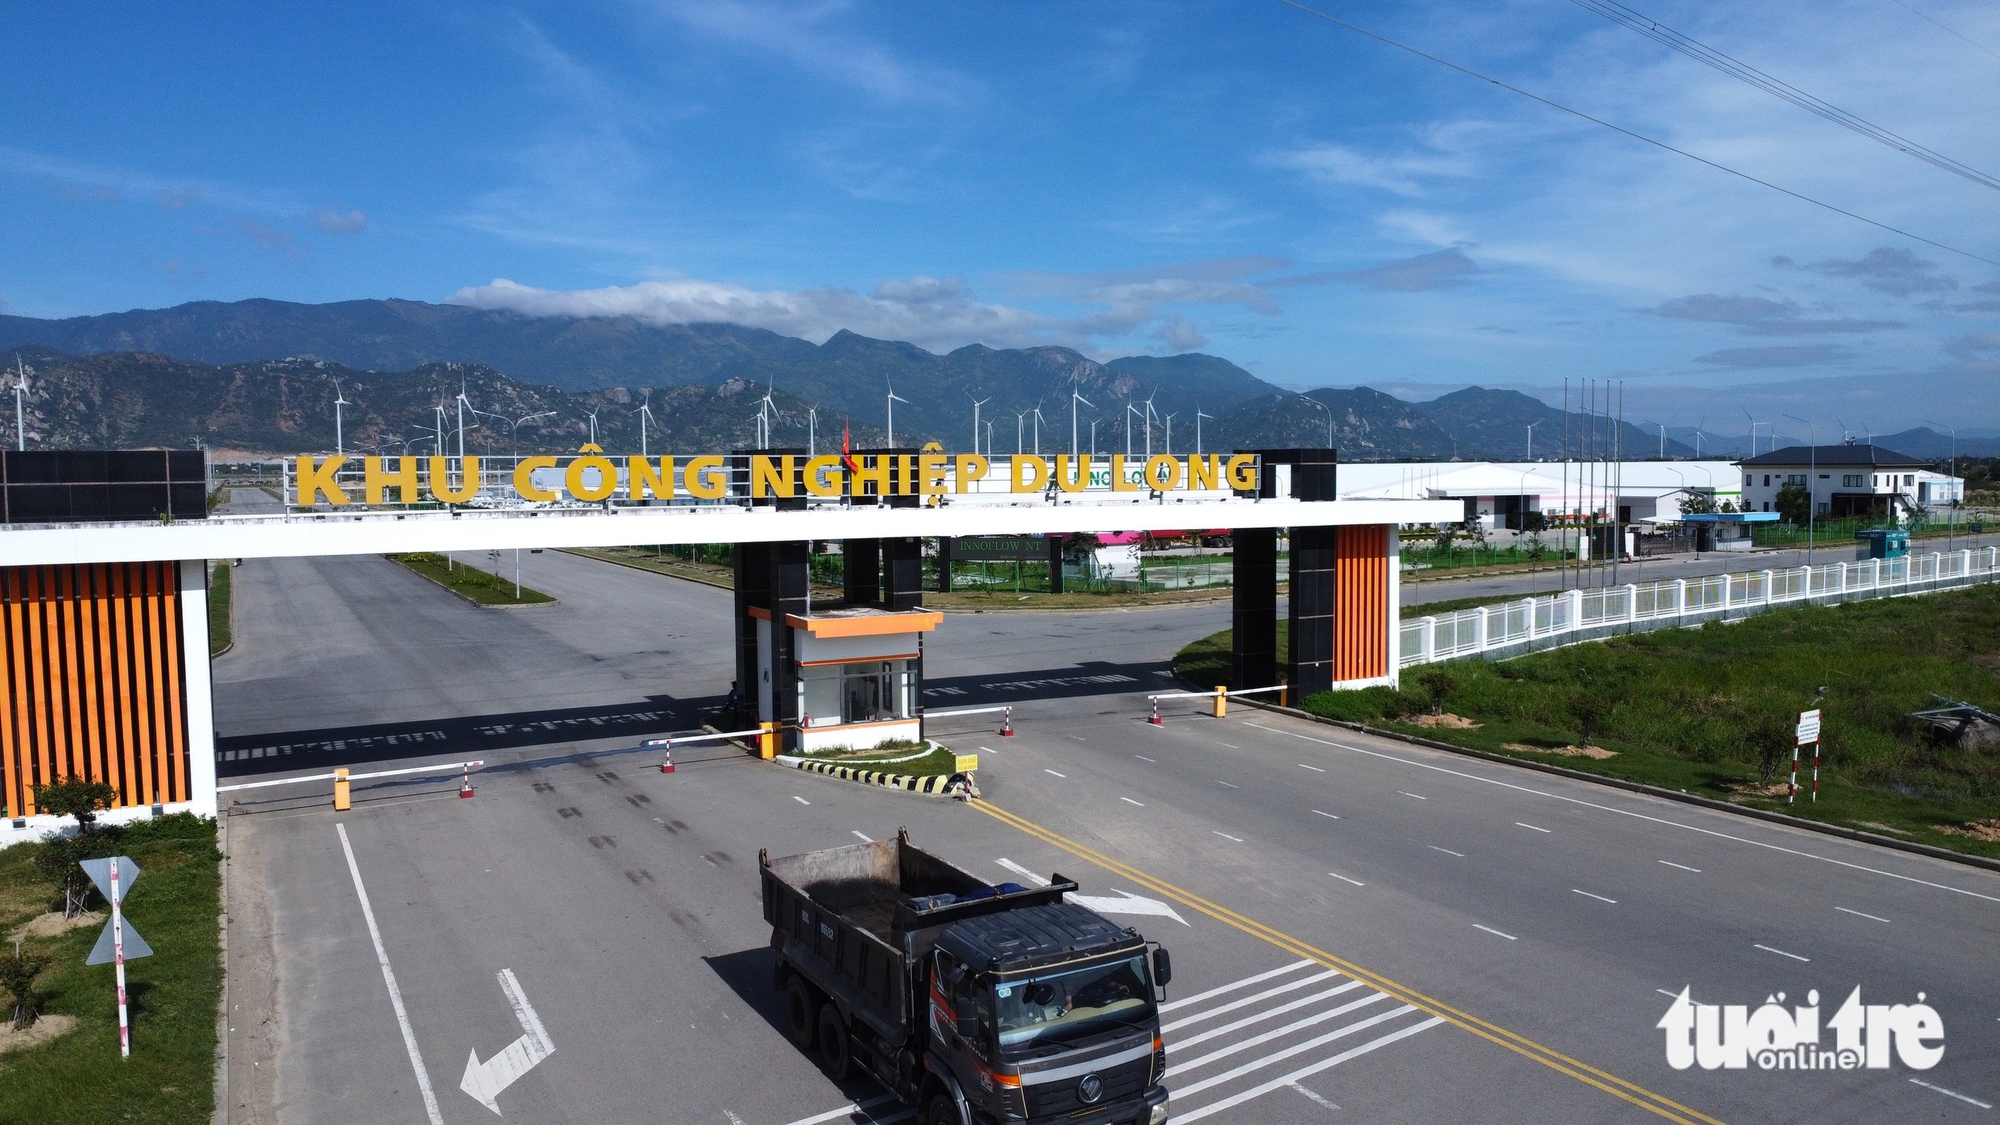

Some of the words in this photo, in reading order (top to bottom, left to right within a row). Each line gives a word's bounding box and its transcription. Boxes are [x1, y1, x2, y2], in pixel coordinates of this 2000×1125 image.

[296, 455, 481, 507] KHU
[513, 442, 727, 503] CÔNG
[752, 442, 989, 507] NGHIỆP
[1011, 453, 1092, 495] DU
[1113, 453, 1259, 493] LONG
[960, 541, 1020, 550] INNOFLOW
[1026, 541, 1042, 550] NT
